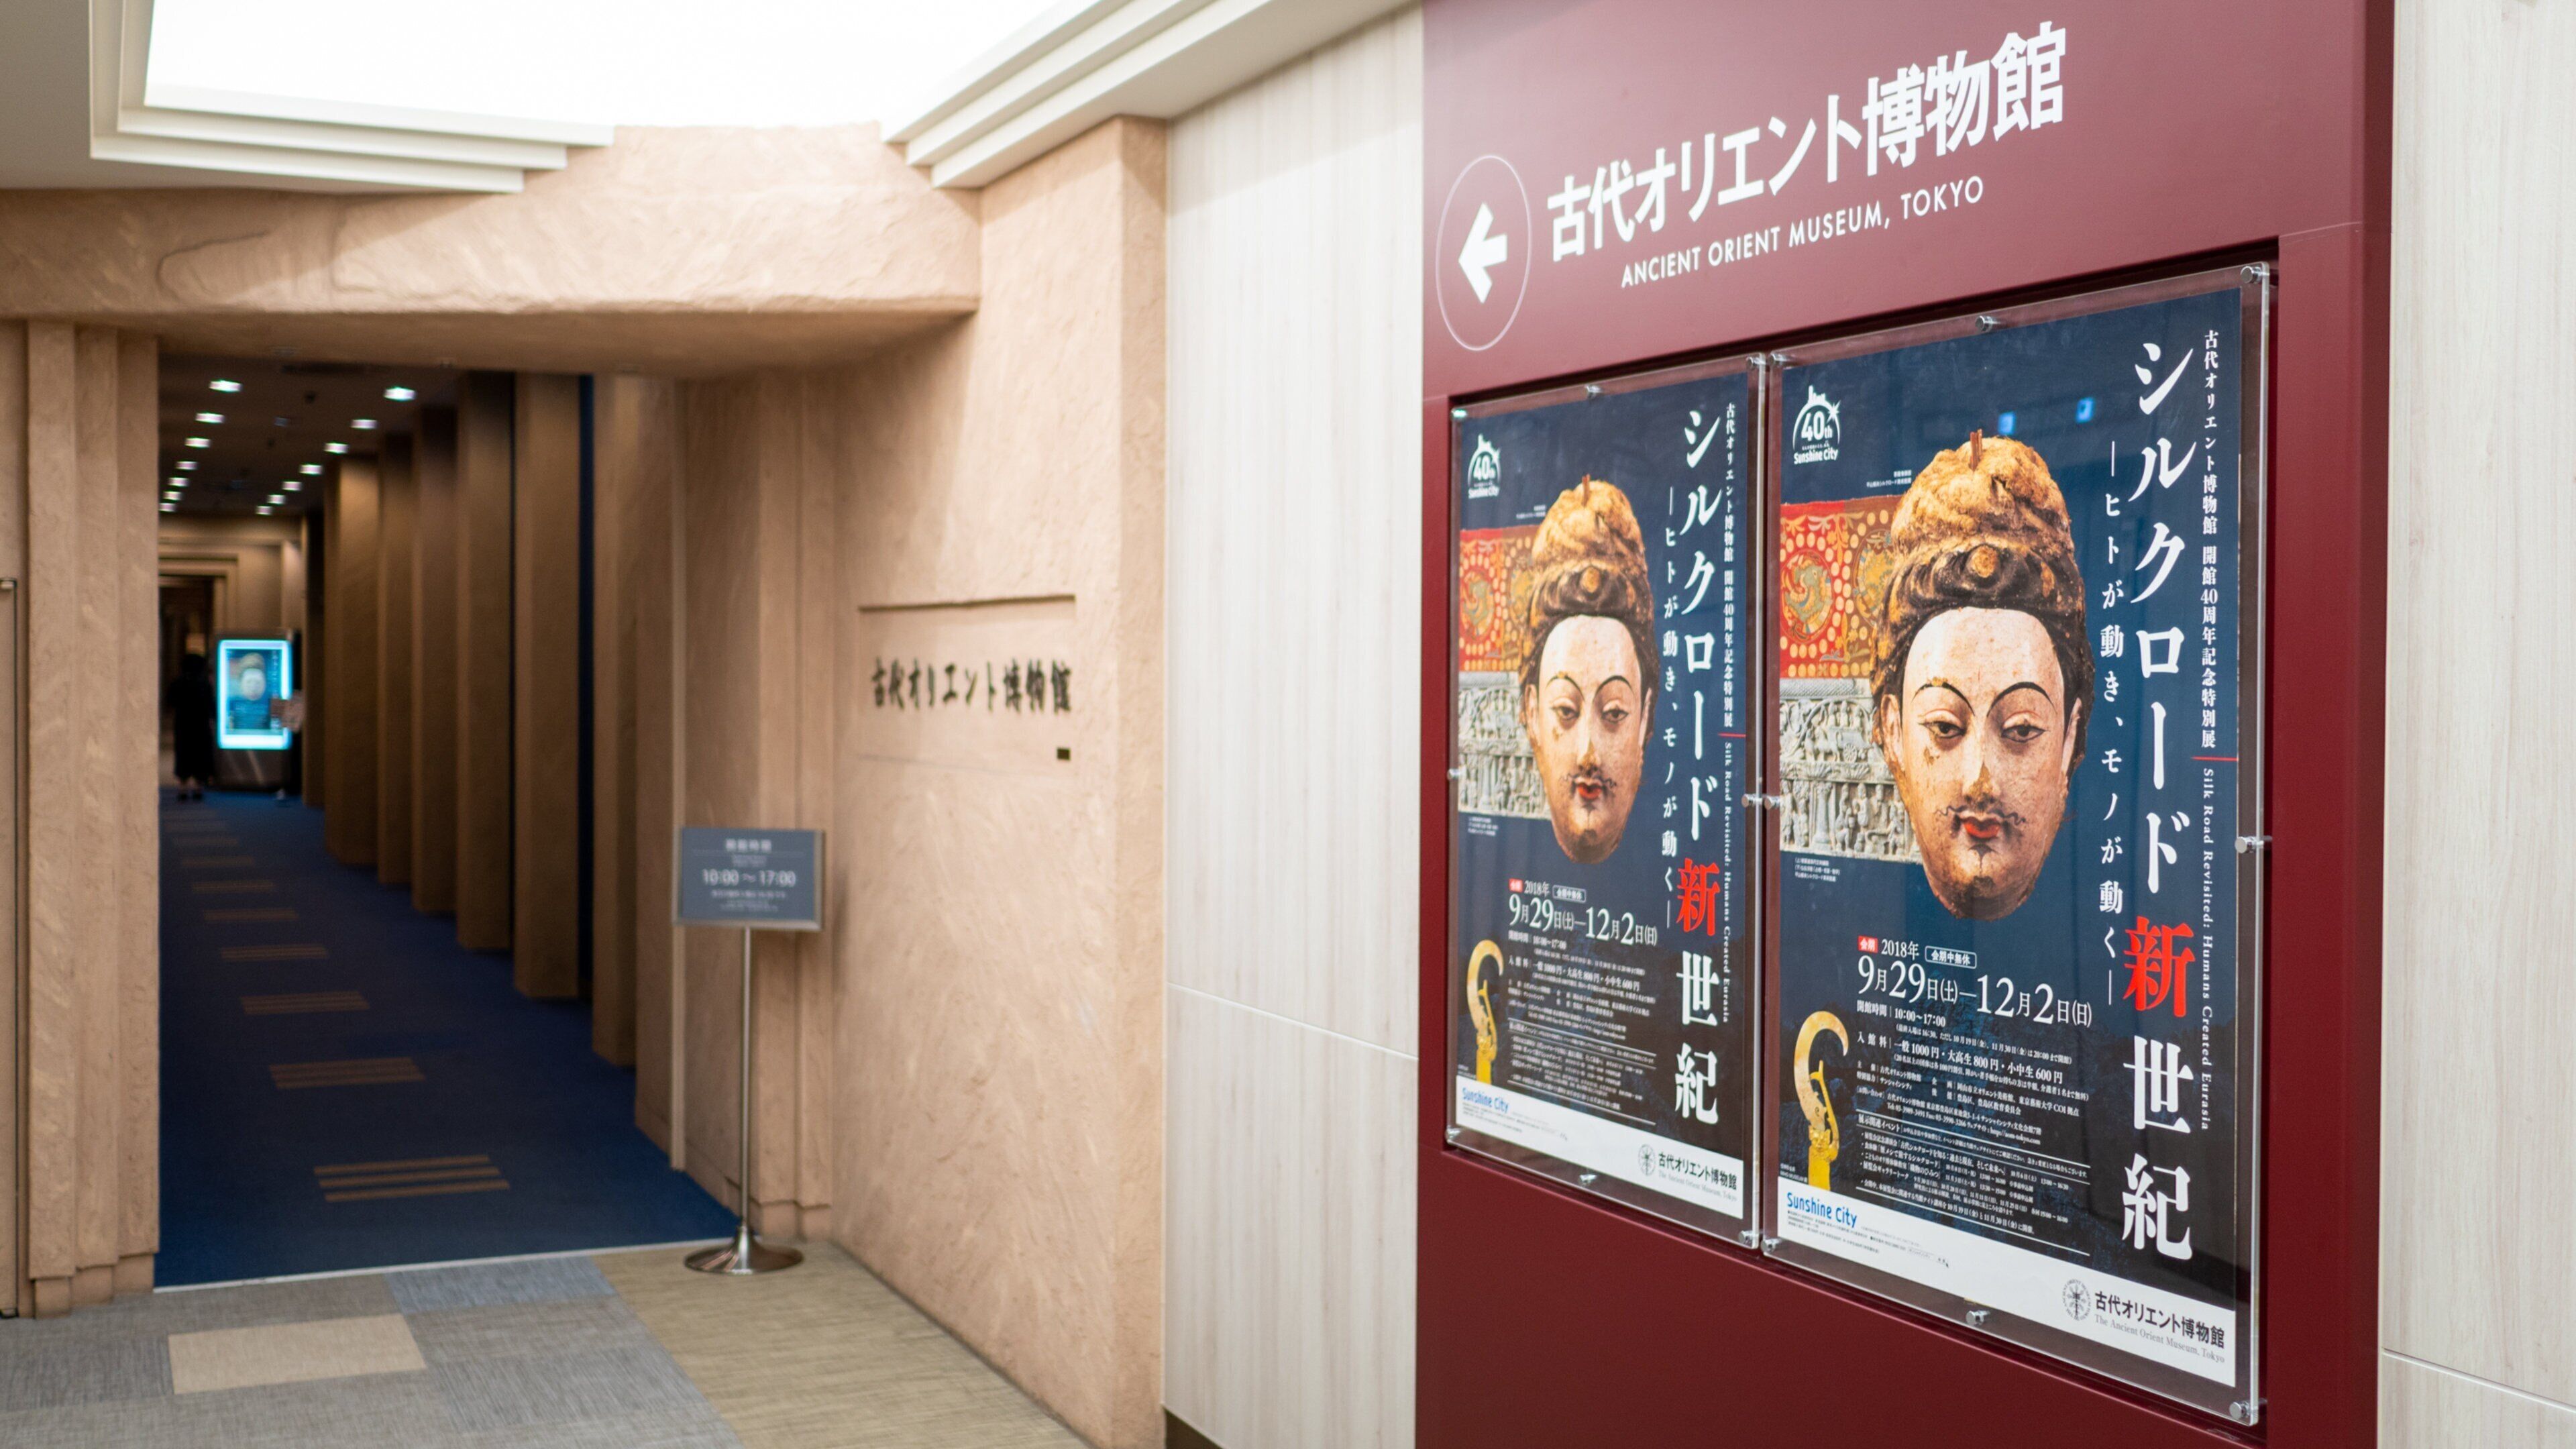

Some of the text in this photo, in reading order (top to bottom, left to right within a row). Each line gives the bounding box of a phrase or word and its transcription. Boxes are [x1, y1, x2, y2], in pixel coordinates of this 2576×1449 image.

[1548, 21, 2067, 262] 古代オリエント博物館
[1621, 175, 1984, 288] ANCIENT ORIENT MUSEUM, TOKYO
[1801, 411, 1833, 441] 40th
[1794, 446, 1839, 464] Sunshine City
[2200, 329, 2220, 749] 古代オリエント博物館 開館40周年記念特別展
[1723, 402, 1736, 728] 古代オリエント博物館 開館40周年記念特別展
[871, 657, 1072, 715] 古代オリエント博物館
[1675, 410, 1722, 1125] シルクロード新世紀
[1724, 741, 1732, 763] Silk
[1724, 767, 1732, 802] Road
[2122, 343, 2197, 1261] シルクロード新世紀
[702, 868, 739, 887] 10:00
[759, 869, 796, 888] 17:00
[1523, 880, 1550, 898] 2018年
[1723, 872, 1731, 922] Humans
[1723, 926, 1731, 969] Created
[1881, 938, 1920, 961] 2018年
[1931, 949, 1971, 966] 会期中無休
[2201, 768, 2214, 1130] Silk Road Revisited: Humans Created Eurasia
[1856, 1000, 1888, 1019] 開館時間
[1462, 1087, 1493, 1108] Sunshine
[1494, 1097, 1509, 1114] City
[1658, 1151, 1737, 1191] 古代オリエント博物館
[1787, 1191, 1858, 1229] Sunshine City
[2095, 1291, 2225, 1349] 古代オリエント博物館
[2095, 1313, 2108, 1327] The
[2110, 1317, 2139, 1336] Ancient
[2140, 1325, 2164, 1344] Orient
[2202, 1347, 2225, 1364] Tokyo
